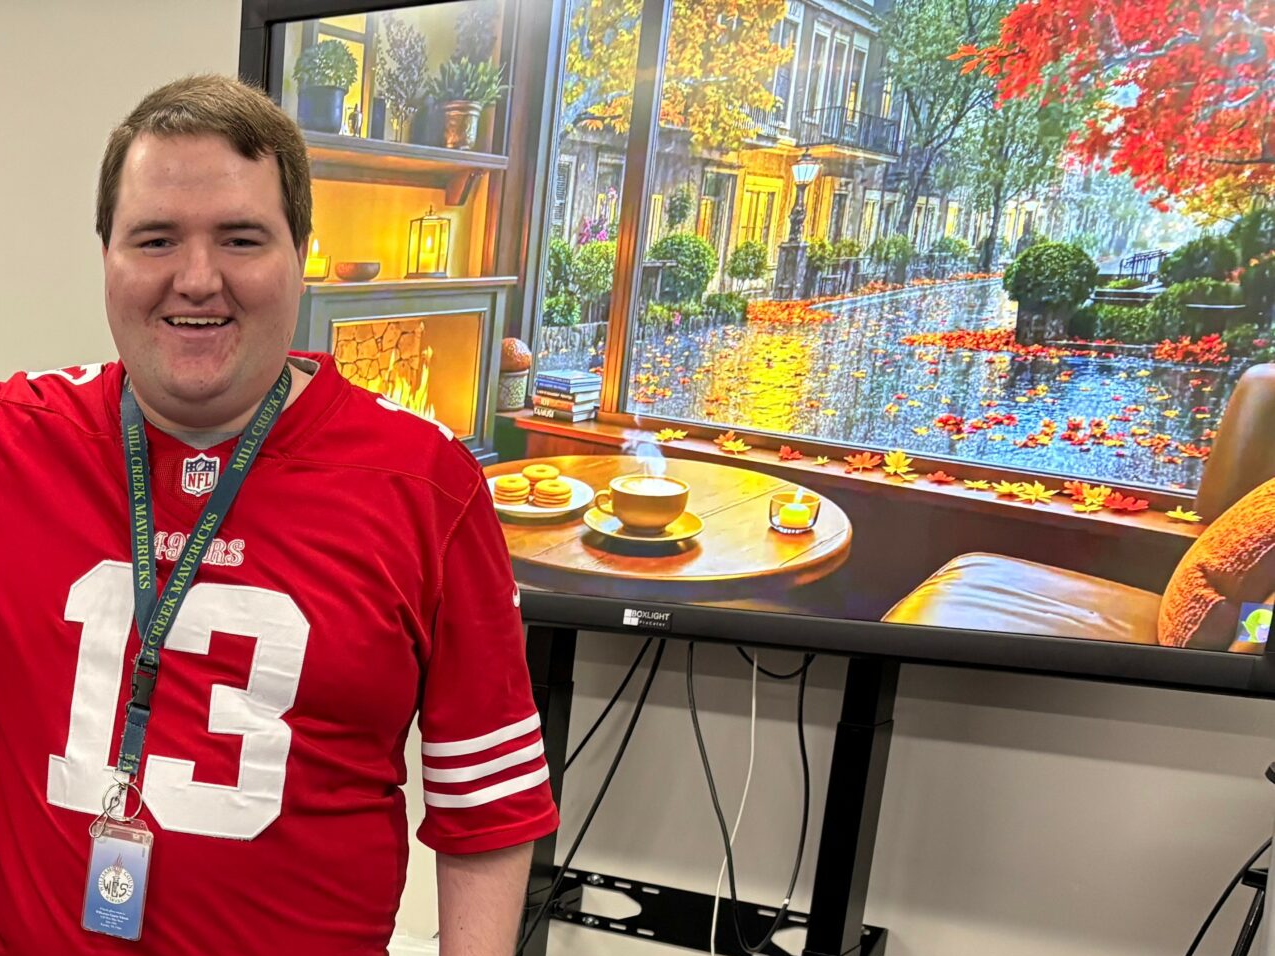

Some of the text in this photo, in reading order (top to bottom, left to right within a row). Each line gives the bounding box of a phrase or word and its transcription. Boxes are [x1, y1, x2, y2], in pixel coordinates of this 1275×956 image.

[232, 437, 257, 472] MILL
[251, 398, 281, 437] CREEK
[127, 424, 151, 590] MILL CREEK MAVERICKS
[187, 473, 212, 488] NFL
[154, 531, 246, 567] 49RS
[147, 595, 177, 651] CREEK
[173, 512, 219, 595] MAVERICKS
[632, 610, 670, 621] BOXLIGHT
[46, 559, 310, 840] 13
[103, 879, 130, 899] WCS
